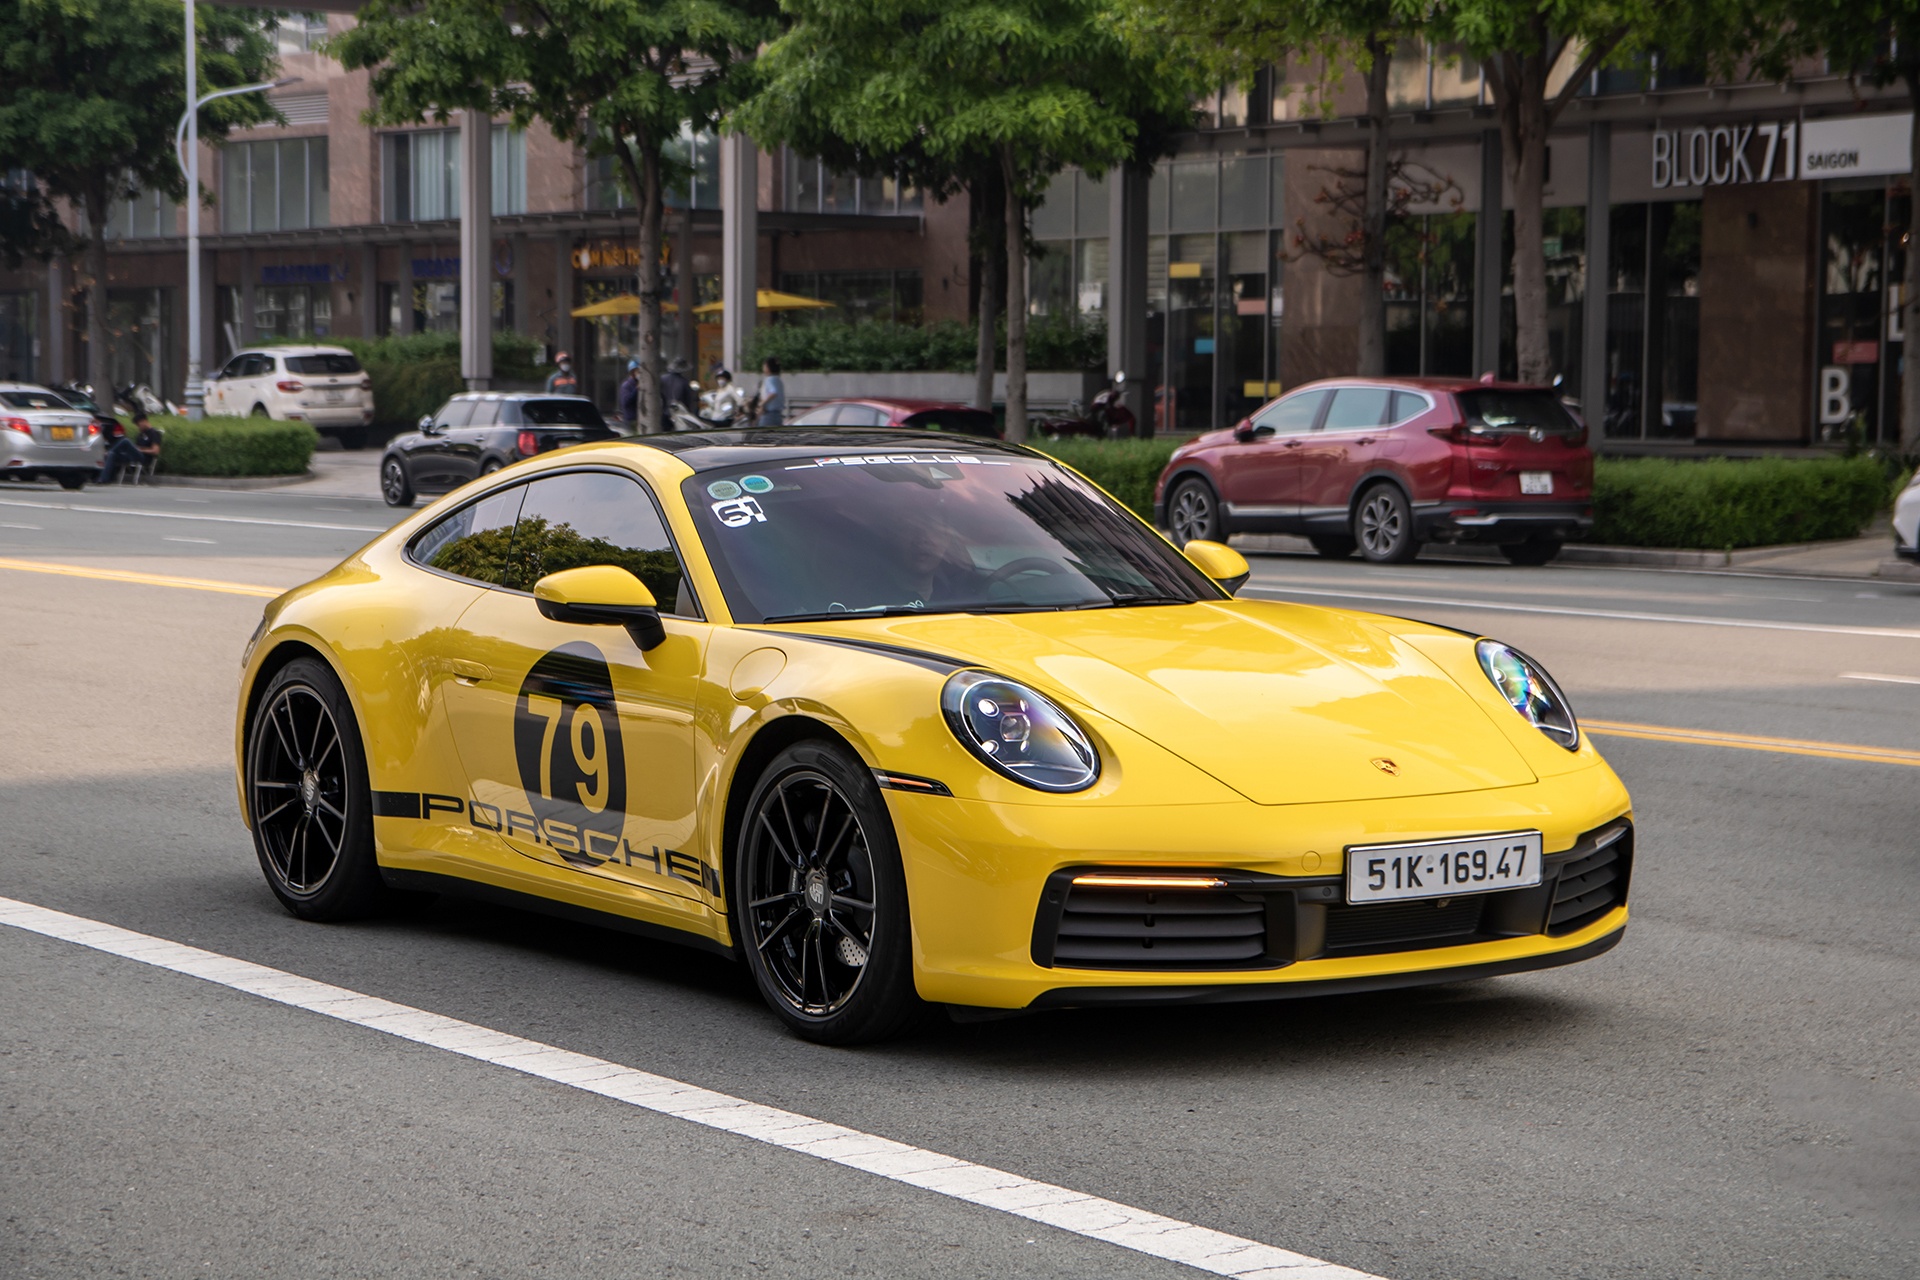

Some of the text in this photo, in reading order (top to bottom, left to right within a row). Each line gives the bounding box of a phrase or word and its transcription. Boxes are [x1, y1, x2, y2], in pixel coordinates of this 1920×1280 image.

[1652, 120, 1797, 188] BLOCK 71
[1807, 151, 1859, 170] SAIGON
[1820, 367, 1850, 424] B
[527, 693, 609, 814] 79
[421, 792, 703, 888] PORSCHE
[1367, 844, 1528, 892] 51K-169.47
